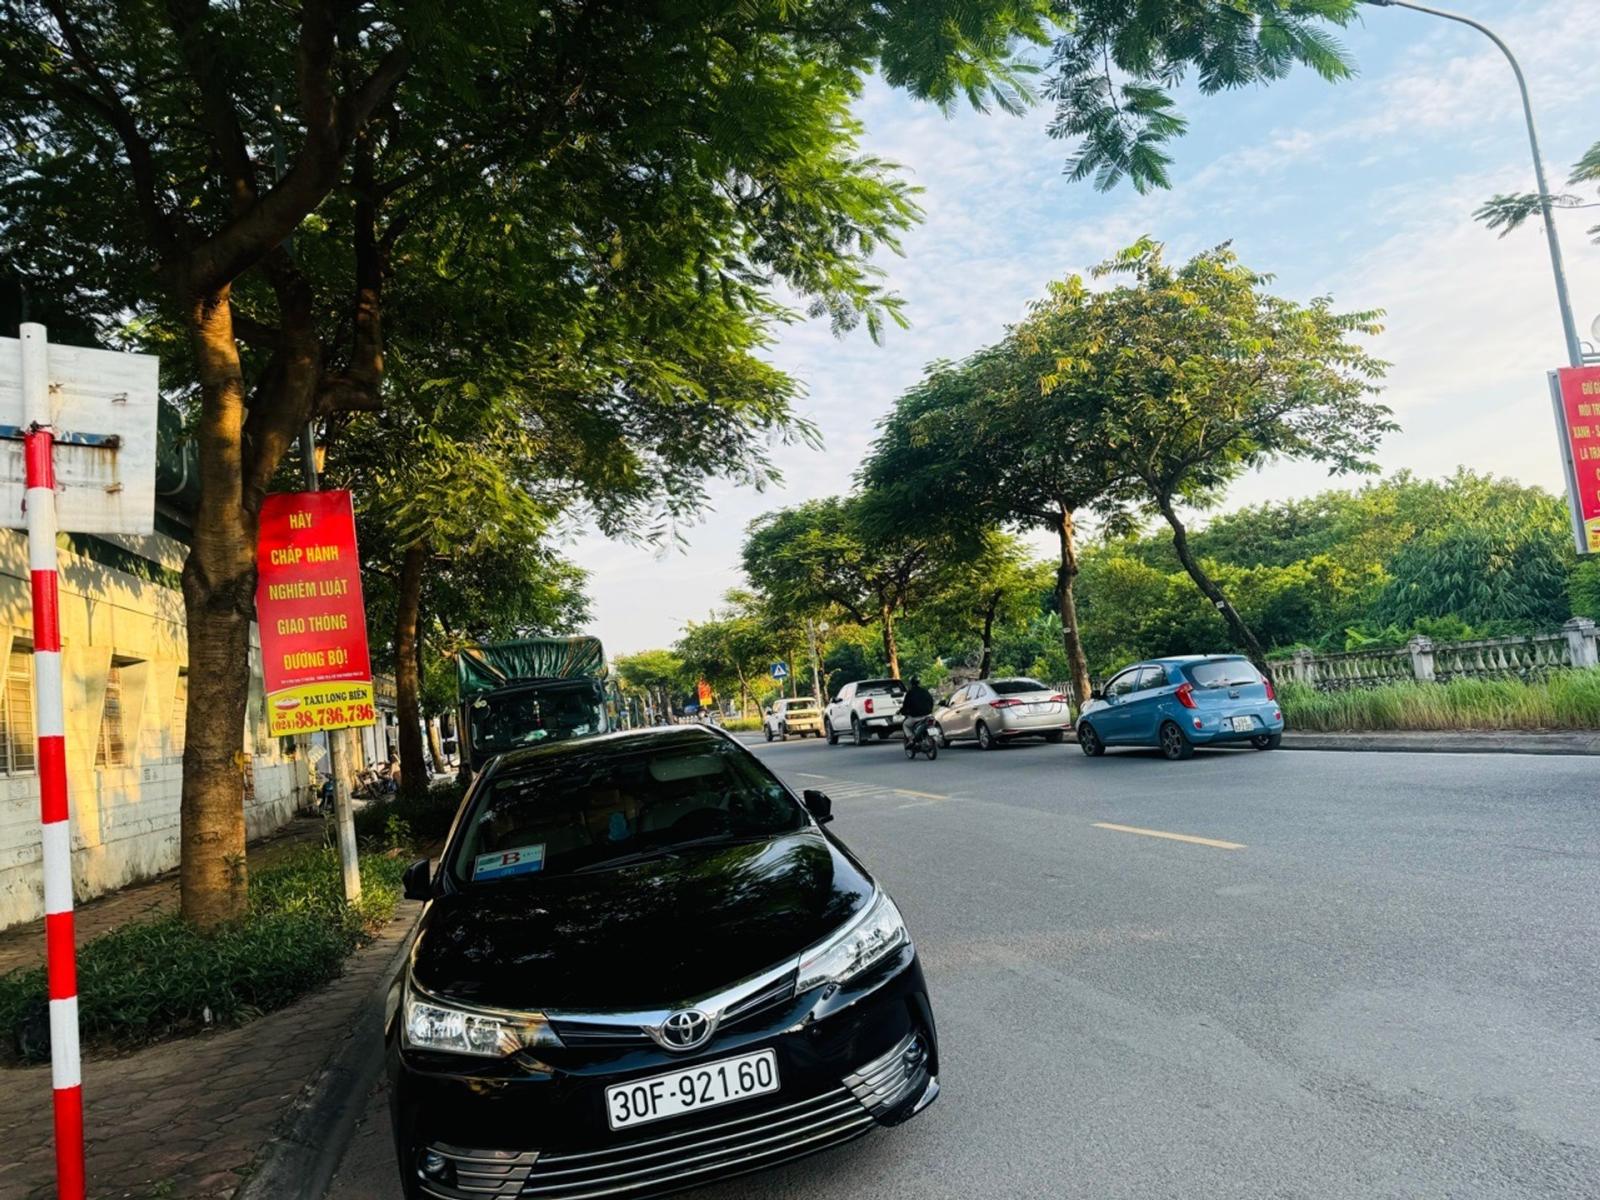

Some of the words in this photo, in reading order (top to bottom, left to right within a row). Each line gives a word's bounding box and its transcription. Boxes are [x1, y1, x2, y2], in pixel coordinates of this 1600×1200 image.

[289, 510, 312, 529] HÃY
[271, 543, 303, 565] CHẤP
[306, 543, 339, 562] HÀNH
[269, 580, 317, 600] NGHIÊM
[319, 577, 347, 599] LUẬT
[277, 617, 305, 635] GIAO
[308, 612, 347, 632] THÔNG
[283, 649, 325, 670] ĐƯỜNG
[304, 695, 324, 706] TAXI
[326, 692, 347, 703] LONG
[348, 688, 368, 700] BIÊN
[612, 1057, 773, 1122] 30F-921.60
